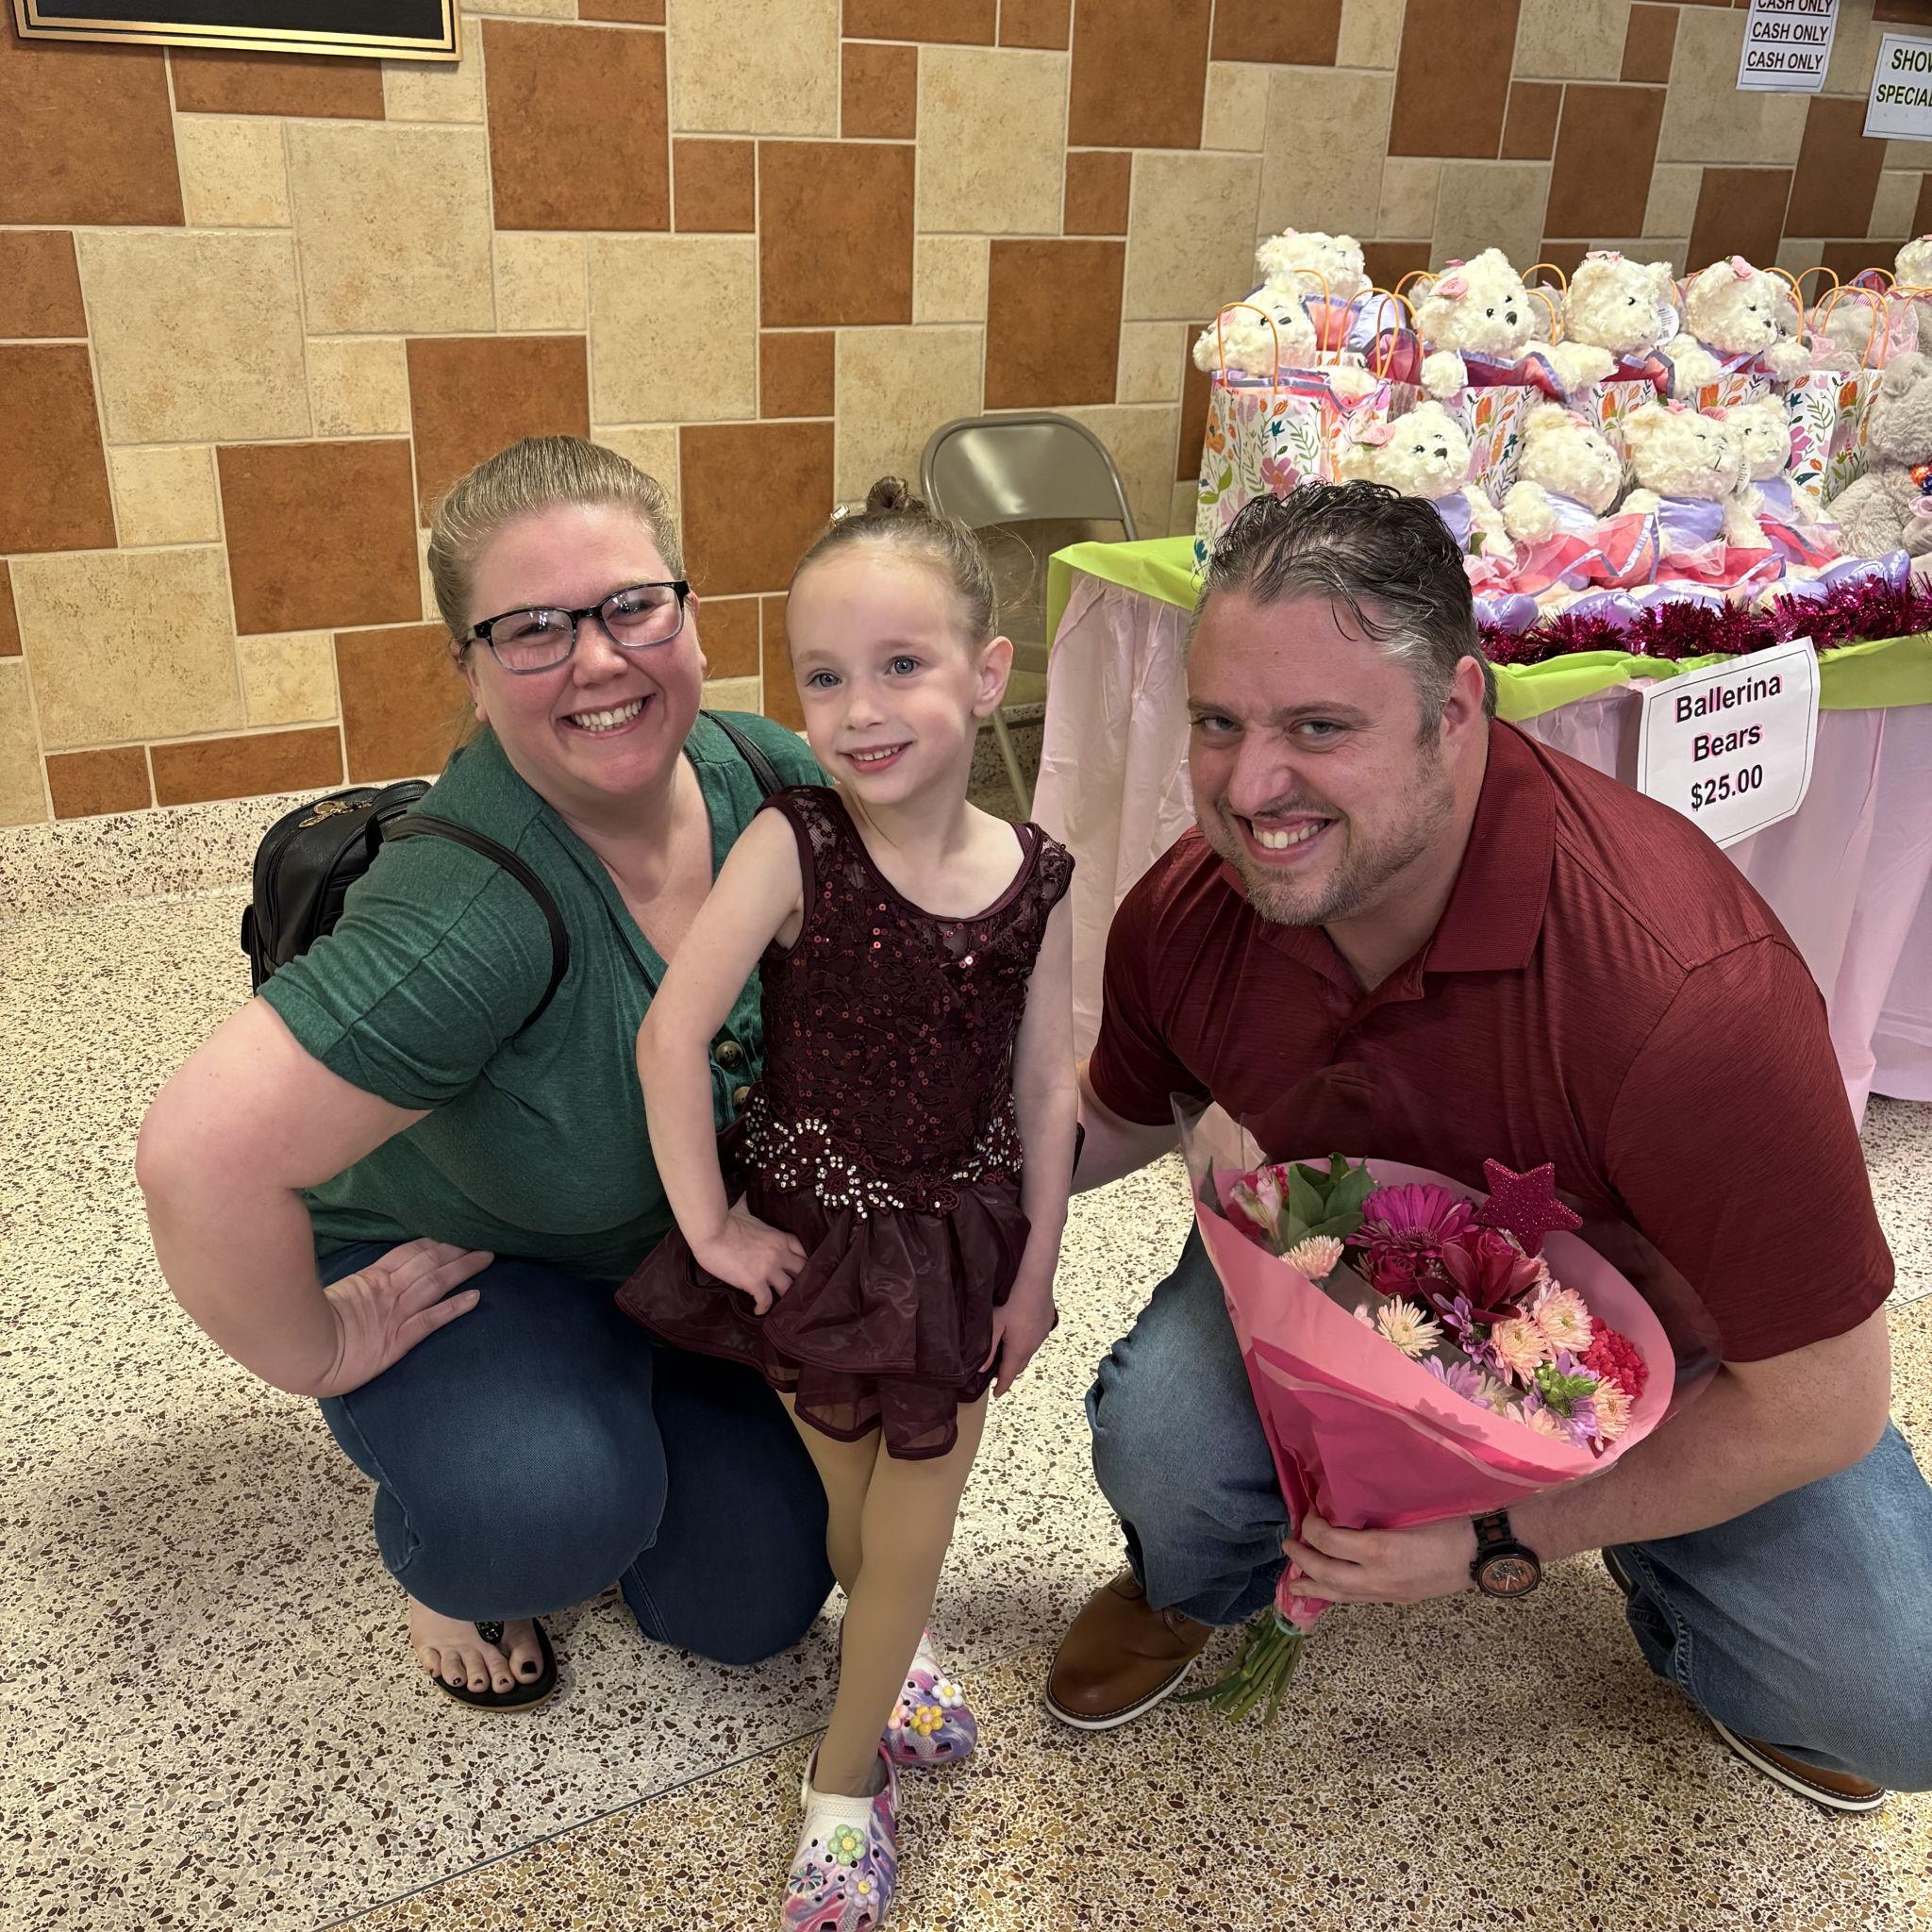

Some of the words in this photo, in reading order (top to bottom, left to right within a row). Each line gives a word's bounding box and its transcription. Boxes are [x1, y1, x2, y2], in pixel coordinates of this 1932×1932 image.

[1757, 0, 1794, 10] CASH
[1798, 0, 1832, 13] ONLY
[1752, 21, 1790, 40] CASH
[1793, 24, 1829, 42] ONLY
[1747, 50, 1785, 68] CASH
[1788, 53, 1824, 70] ONLY
[1890, 48, 1932, 73] SHO
[1674, 675, 1782, 723] Ballerina
[1691, 724, 1762, 762] Bears
[1690, 764, 1763, 811] $25.00
